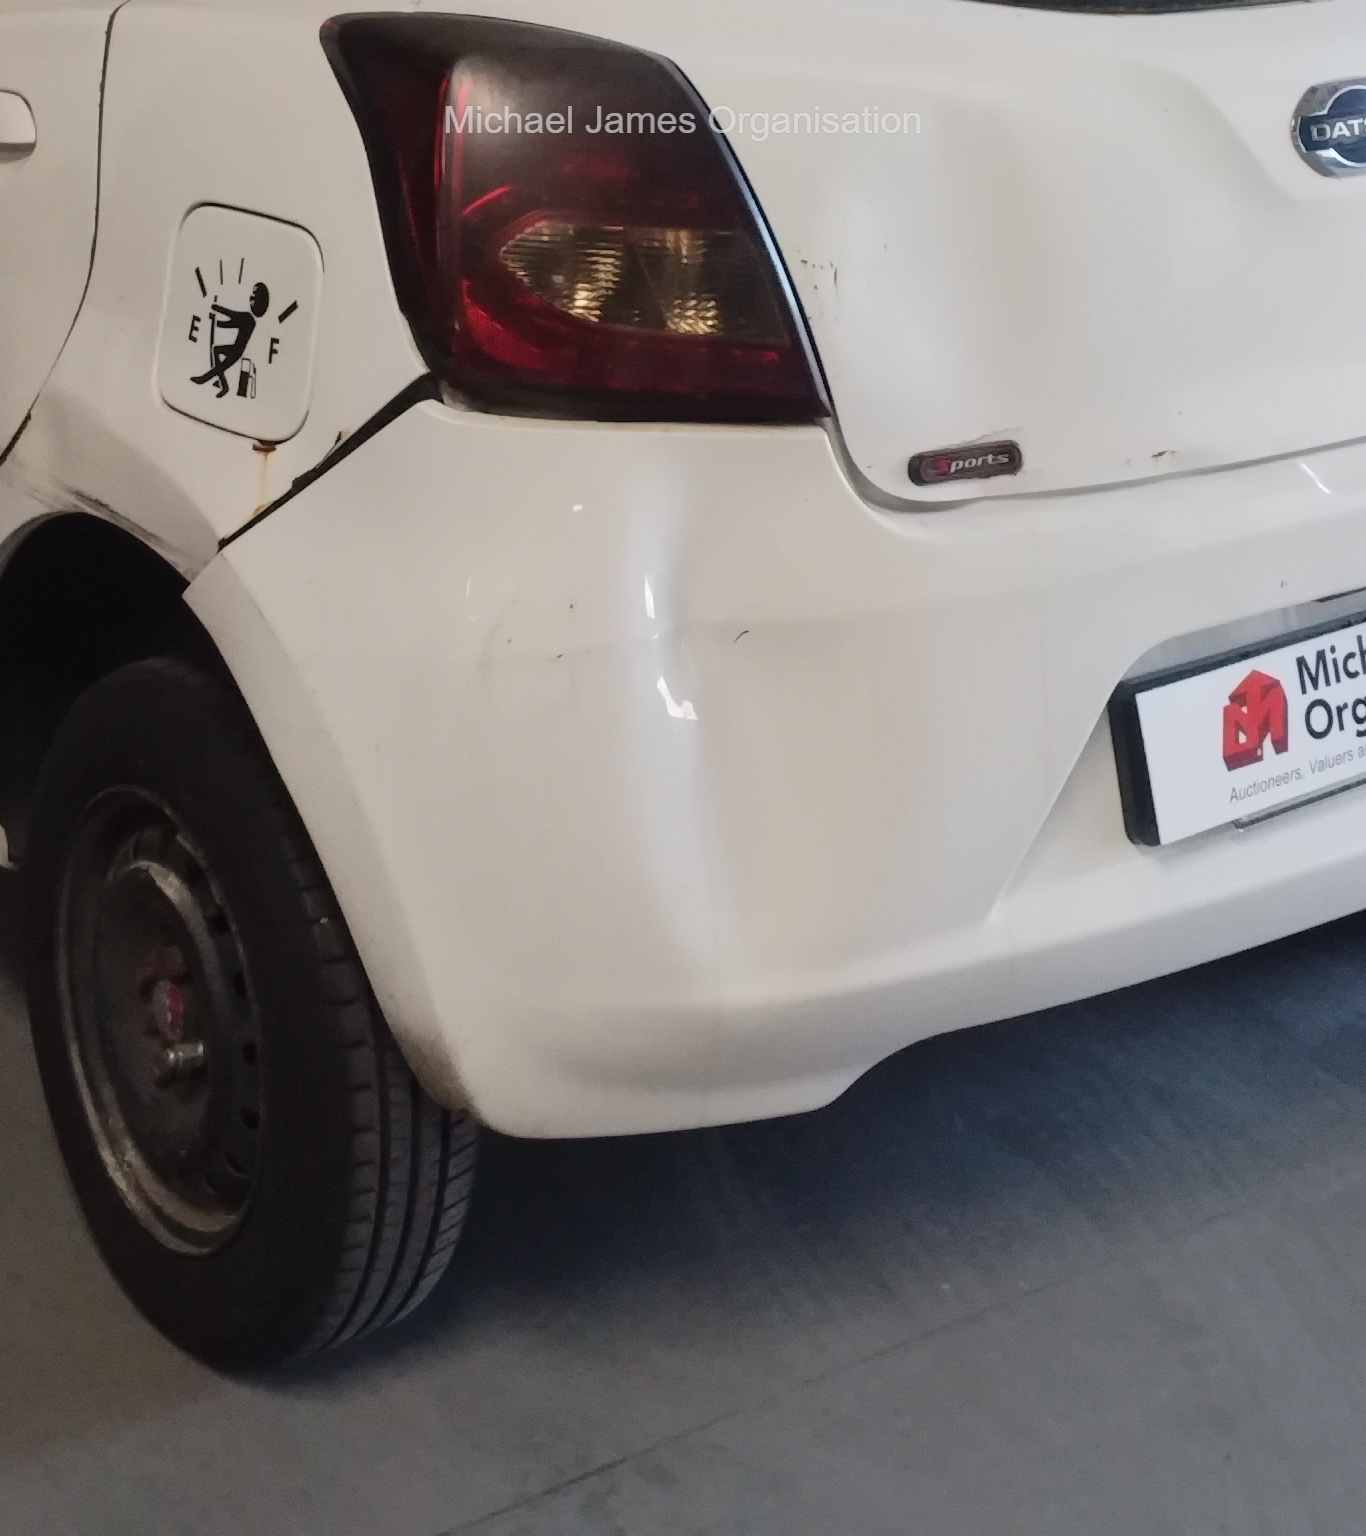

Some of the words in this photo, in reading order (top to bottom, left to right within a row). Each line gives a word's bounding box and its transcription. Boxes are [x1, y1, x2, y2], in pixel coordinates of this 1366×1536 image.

[188, 315, 201, 343] E
[268, 337, 280, 364] F
[1229, 767, 1306, 804] Auctioneers,
[1309, 745, 1354, 776] Valuers
